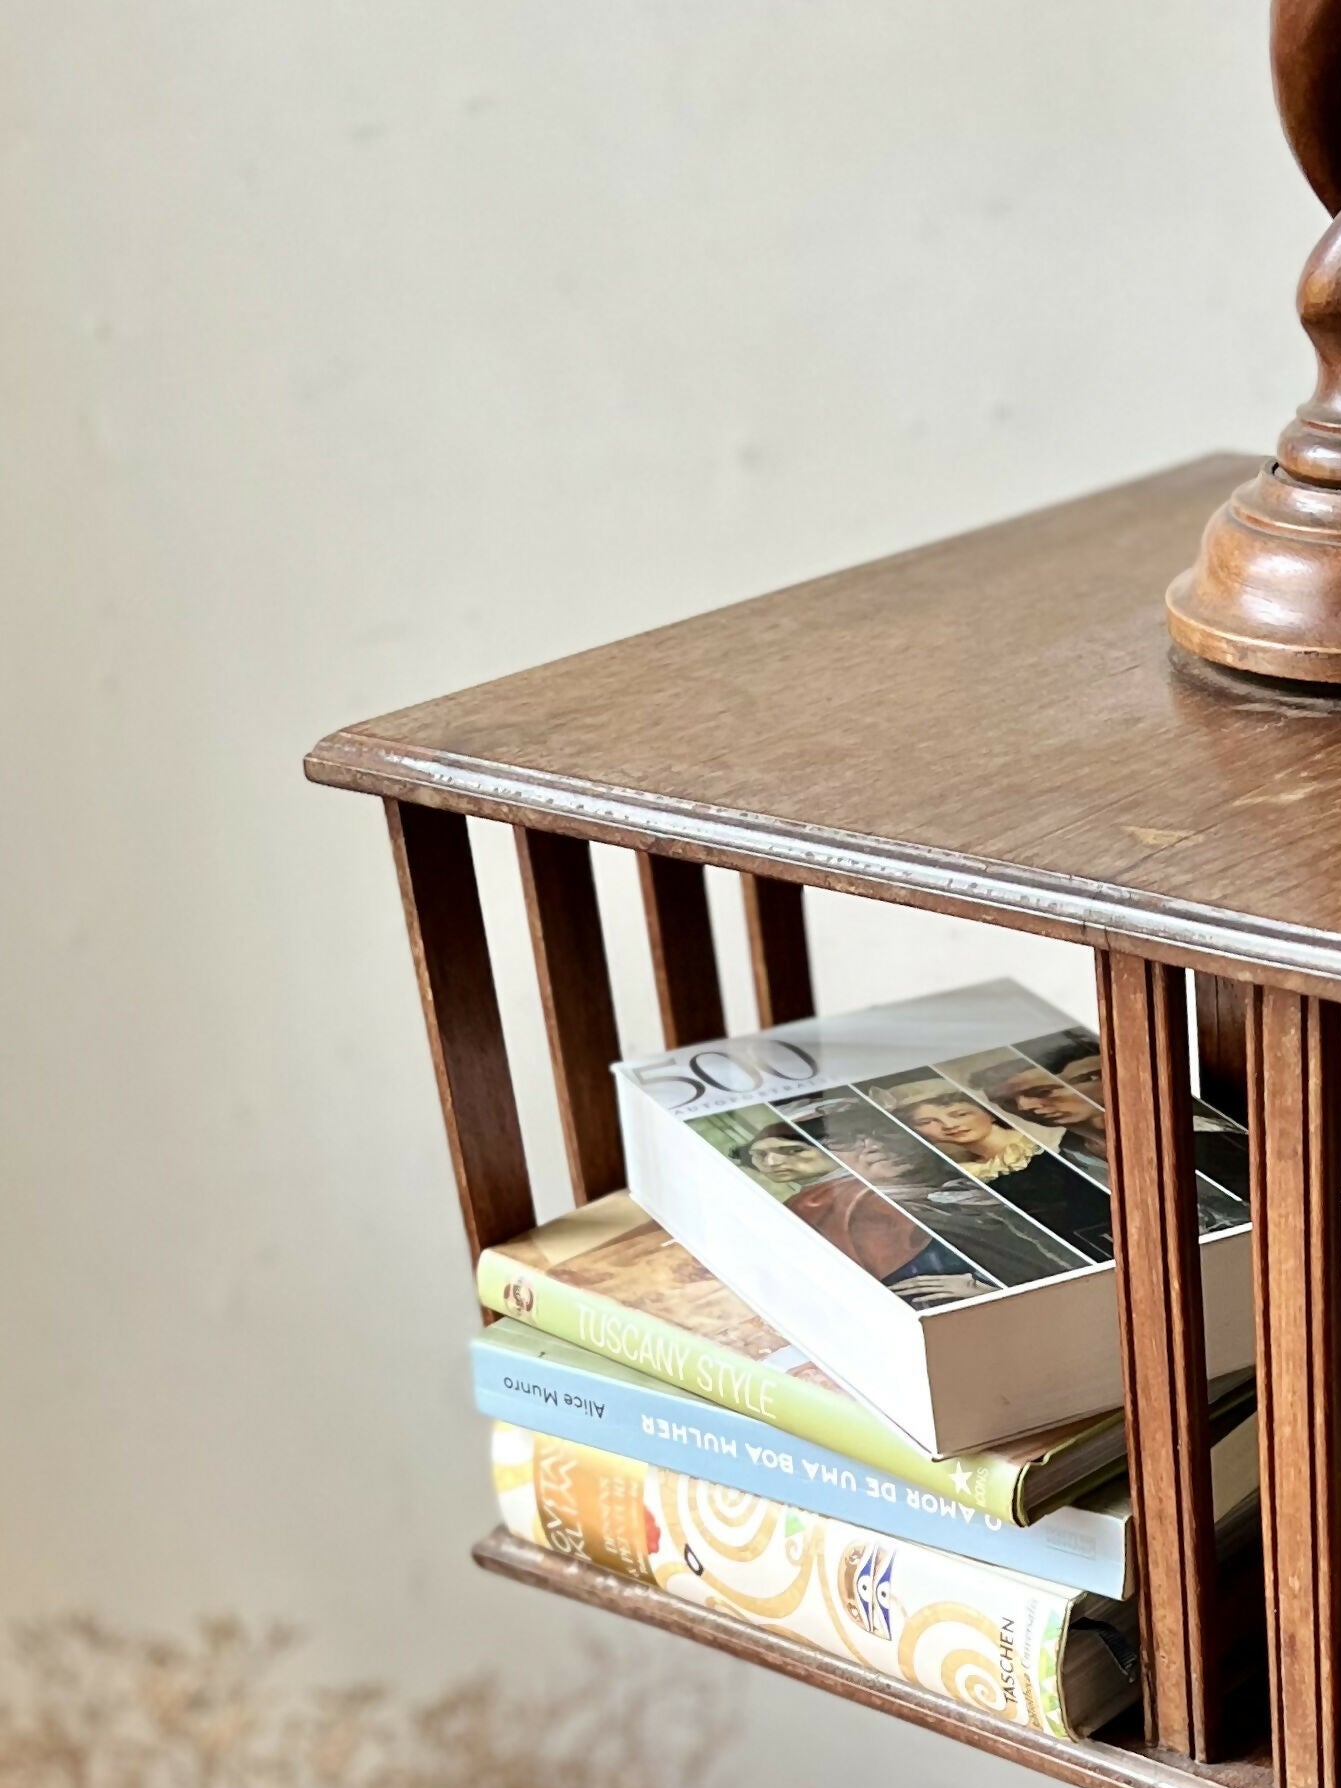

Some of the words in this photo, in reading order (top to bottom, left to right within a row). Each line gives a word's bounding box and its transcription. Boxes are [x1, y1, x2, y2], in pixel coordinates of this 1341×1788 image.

[632, 1039, 819, 1110] 500
[576, 1302, 690, 1381] TUSCANY
[697, 1354, 777, 1419] STYLE
[503, 1377, 558, 1407] Munro
[563, 1393, 605, 1419] Alice
[641, 1414, 737, 1458] MULHER
[744, 1443, 794, 1474] BOA
[802, 1459, 857, 1492] UMA
[865, 1475, 897, 1503] DE
[905, 1487, 976, 1523] AMOR
[975, 1466, 989, 1508] ICONS
[999, 1617, 1018, 1704] TASCHEN
